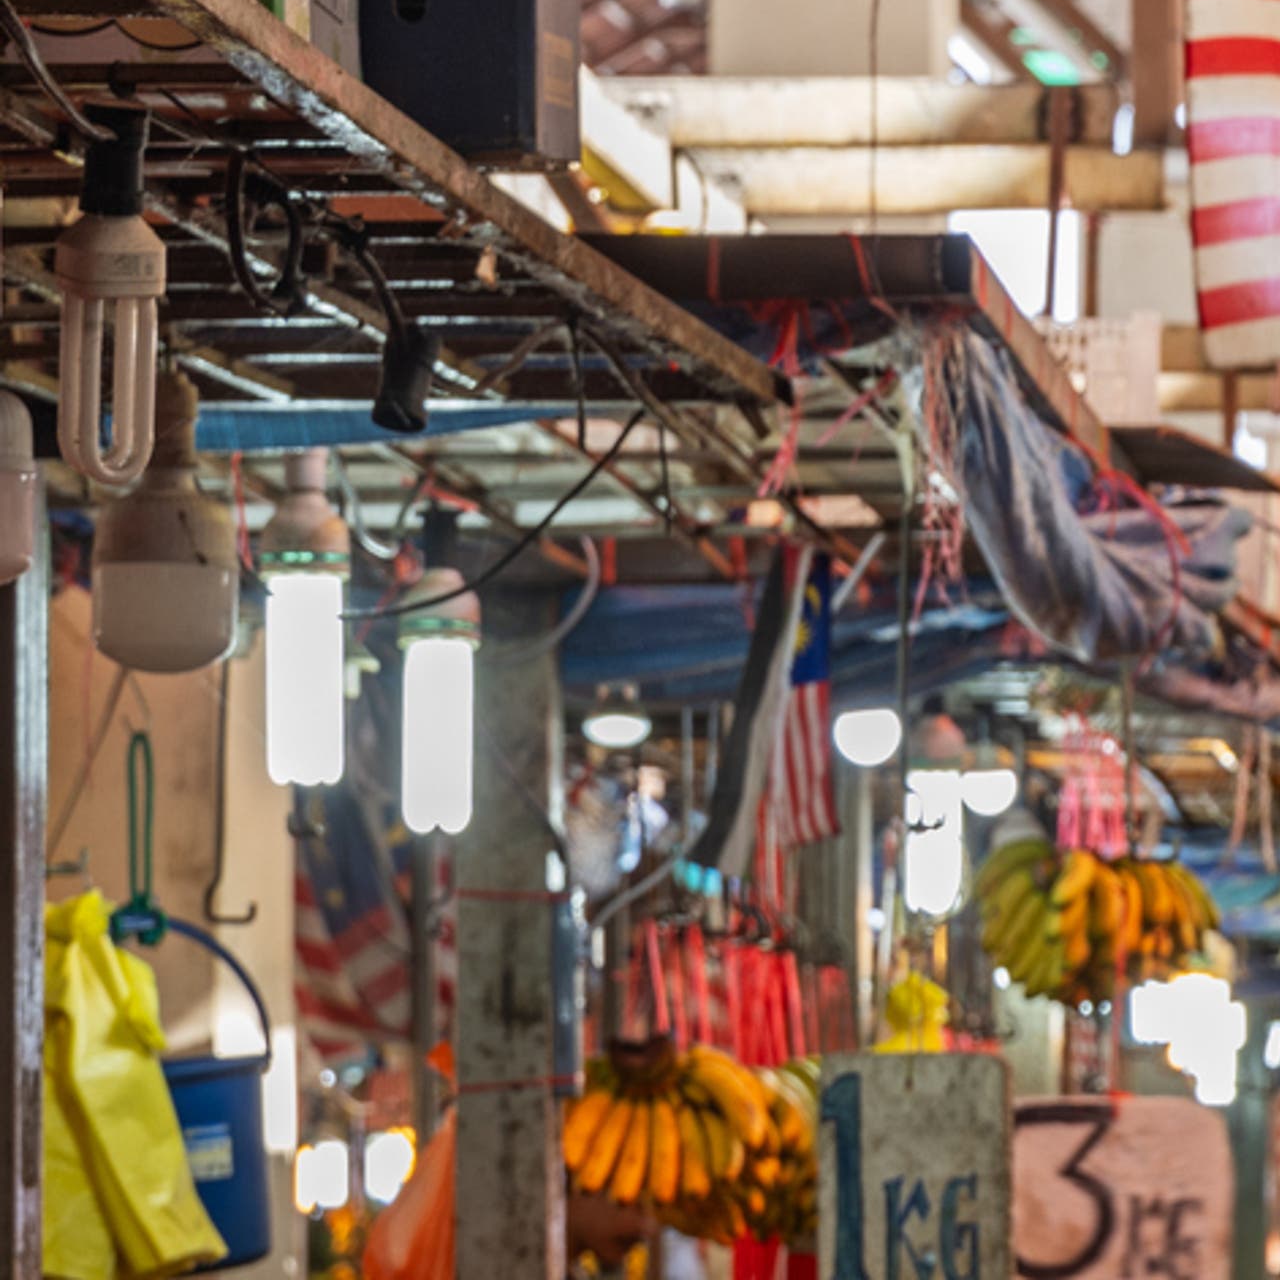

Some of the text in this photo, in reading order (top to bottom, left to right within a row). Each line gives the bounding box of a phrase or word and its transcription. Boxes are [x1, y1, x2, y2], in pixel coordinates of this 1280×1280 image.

[820, 1072, 979, 1280] 1 KG
[1014, 1104, 1115, 1279] 3
